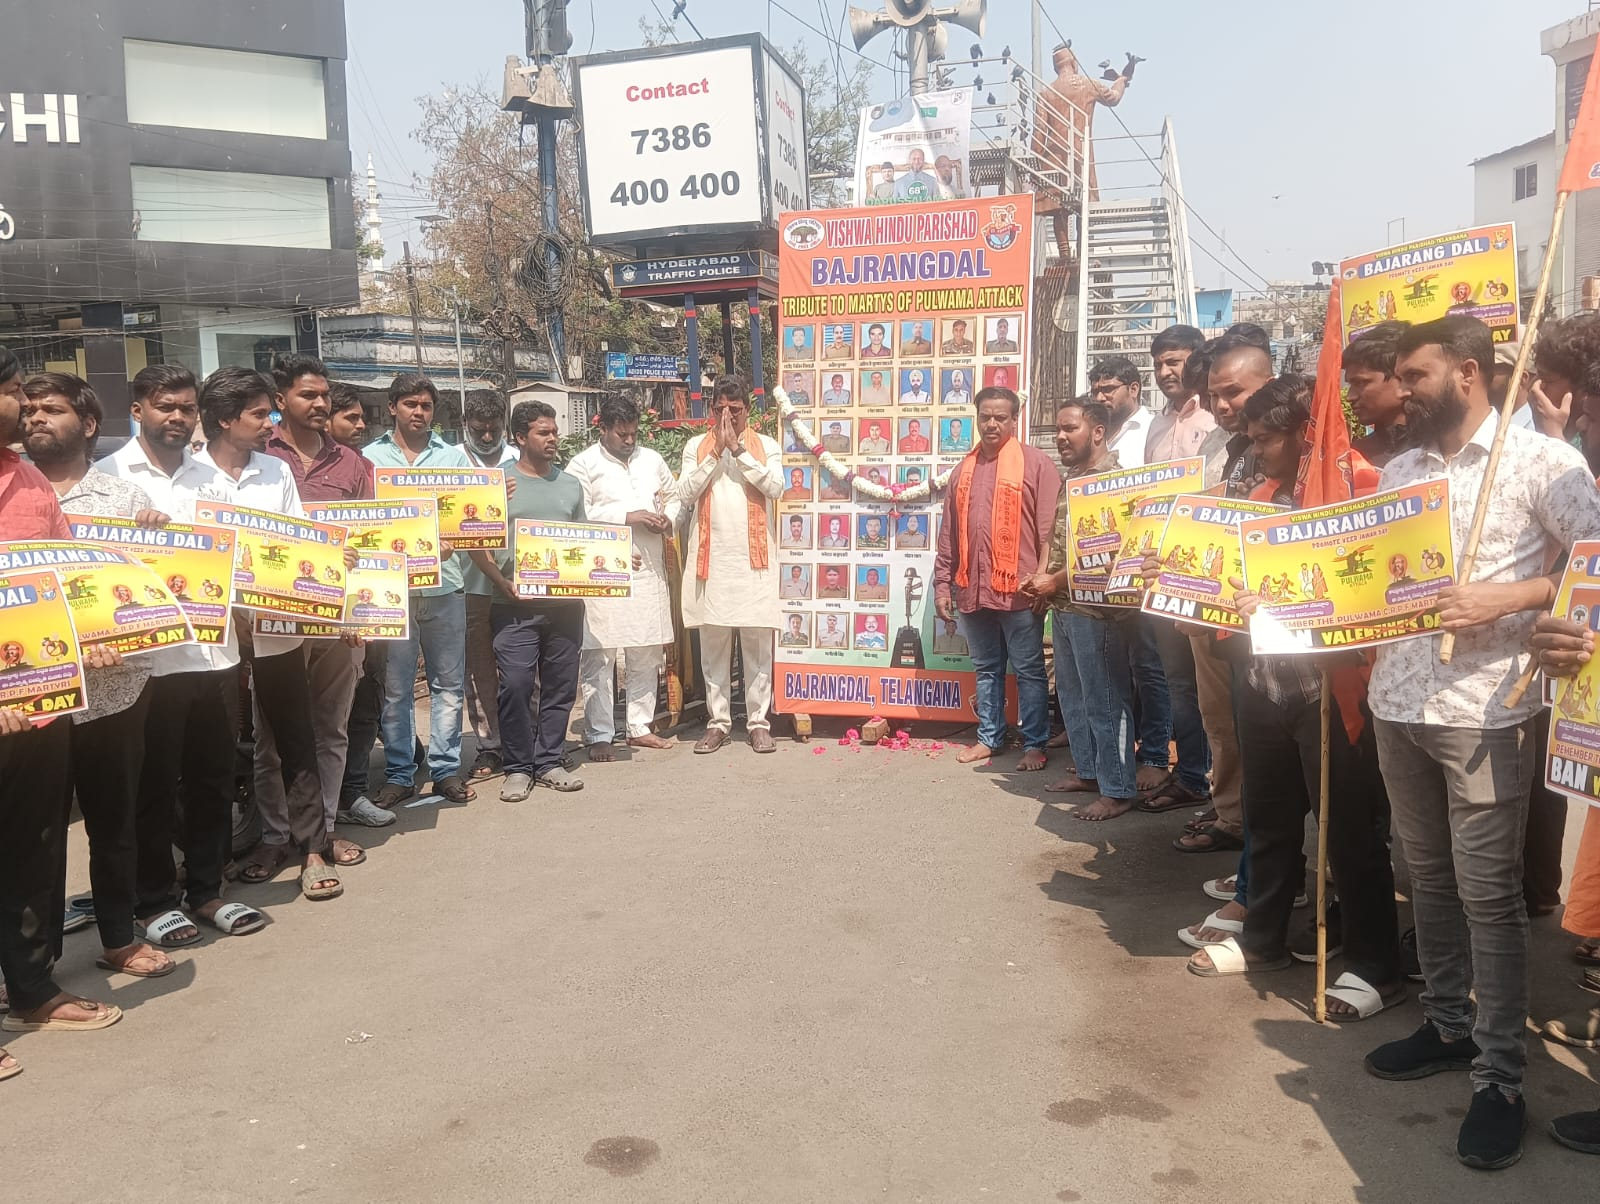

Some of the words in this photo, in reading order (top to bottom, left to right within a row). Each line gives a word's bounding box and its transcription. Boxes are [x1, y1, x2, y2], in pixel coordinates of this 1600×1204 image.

[626, 78, 709, 102] Contact
[775, 90, 795, 122] Contact
[0, 92, 80, 143] HI
[631, 123, 712, 155] 7386
[778, 133, 798, 170] 7386
[610, 178, 668, 206] 400
[680, 170, 740, 200] 400
[774, 178, 789, 209] 400
[826, 218, 872, 248] VISHWA
[876, 214, 913, 244] HINDU
[916, 210, 978, 243] PARISHAD
[648, 256, 740, 270] HYDERABAD
[1364, 246, 1445, 276] BAJARANG
[1451, 238, 1484, 256] DAL
[648, 268, 696, 281] TRAFFIC
[699, 266, 740, 276] POLICE
[811, 248, 991, 286] BAJRANGDAL
[782, 294, 827, 317] TRIBUTE
[830, 294, 845, 315] TO
[848, 290, 894, 314] MARTYS
[896, 290, 913, 312] OF
[916, 288, 974, 310] PULWAMA
[977, 285, 1024, 308] ATTACK
[1492, 329, 1512, 342] AY
[397, 475, 459, 485] BAJARANG
[464, 475, 485, 484] DAL
[1088, 473, 1151, 495] BAJARANG
[1156, 468, 1180, 481] DAL
[317, 508, 386, 521] BAJARANG
[390, 507, 414, 518] DAL
[1143, 503, 1174, 516] BAJA
[1199, 507, 1259, 526] BAJA
[1291, 514, 1312, 522] VISWA
[1313, 510, 1334, 519] HINDU
[1335, 493, 1399, 515] PARISHAD-TELANGANA
[222, 512, 295, 535] BAJARANG
[300, 529, 323, 542] DAL
[1276, 511, 1378, 543] BAJARANG
[1383, 499, 1416, 522] DAL
[76, 525, 168, 545] BAJARANG
[172, 535, 206, 549] DAL
[535, 527, 590, 538] BAJARANG
[594, 531, 614, 539] DAL
[1312, 538, 1341, 549] PROMOTE
[1342, 536, 1358, 544] VEER
[0, 550, 90, 569] BAJARANG
[93, 550, 126, 563] DAL
[359, 558, 384, 569] DAL
[1082, 552, 1110, 568] BAN
[413, 575, 435, 585] DAY
[1109, 575, 1131, 589] BAN
[1341, 573, 1373, 585] PULWAMA
[519, 584, 546, 595] BAN
[610, 588, 628, 596] DAY
[1075, 590, 1103, 602] BAN
[1160, 586, 1201, 599] REMEMBER
[242, 593, 314, 614] VALENTINE'S
[317, 606, 340, 618] DAY
[1151, 593, 1196, 617] BAN
[1283, 620, 1314, 629] EMBER
[1317, 617, 1335, 626] THE
[1337, 610, 1382, 624] PULWAMA
[1412, 600, 1436, 609] MART
[156, 627, 185, 644] DAY
[261, 620, 296, 633] BAN
[380, 627, 402, 636] DAY
[1321, 617, 1418, 646] VALENTINE'S
[1423, 613, 1441, 629] DA
[785, 673, 876, 709] BAJRANGDAL,
[880, 678, 962, 709] TELANGANA
[41, 693, 76, 712] DAY
[1556, 744, 1593, 762] REMEMBER
[1551, 756, 1588, 791] BAN
[158, 916, 186, 932] PUMA
